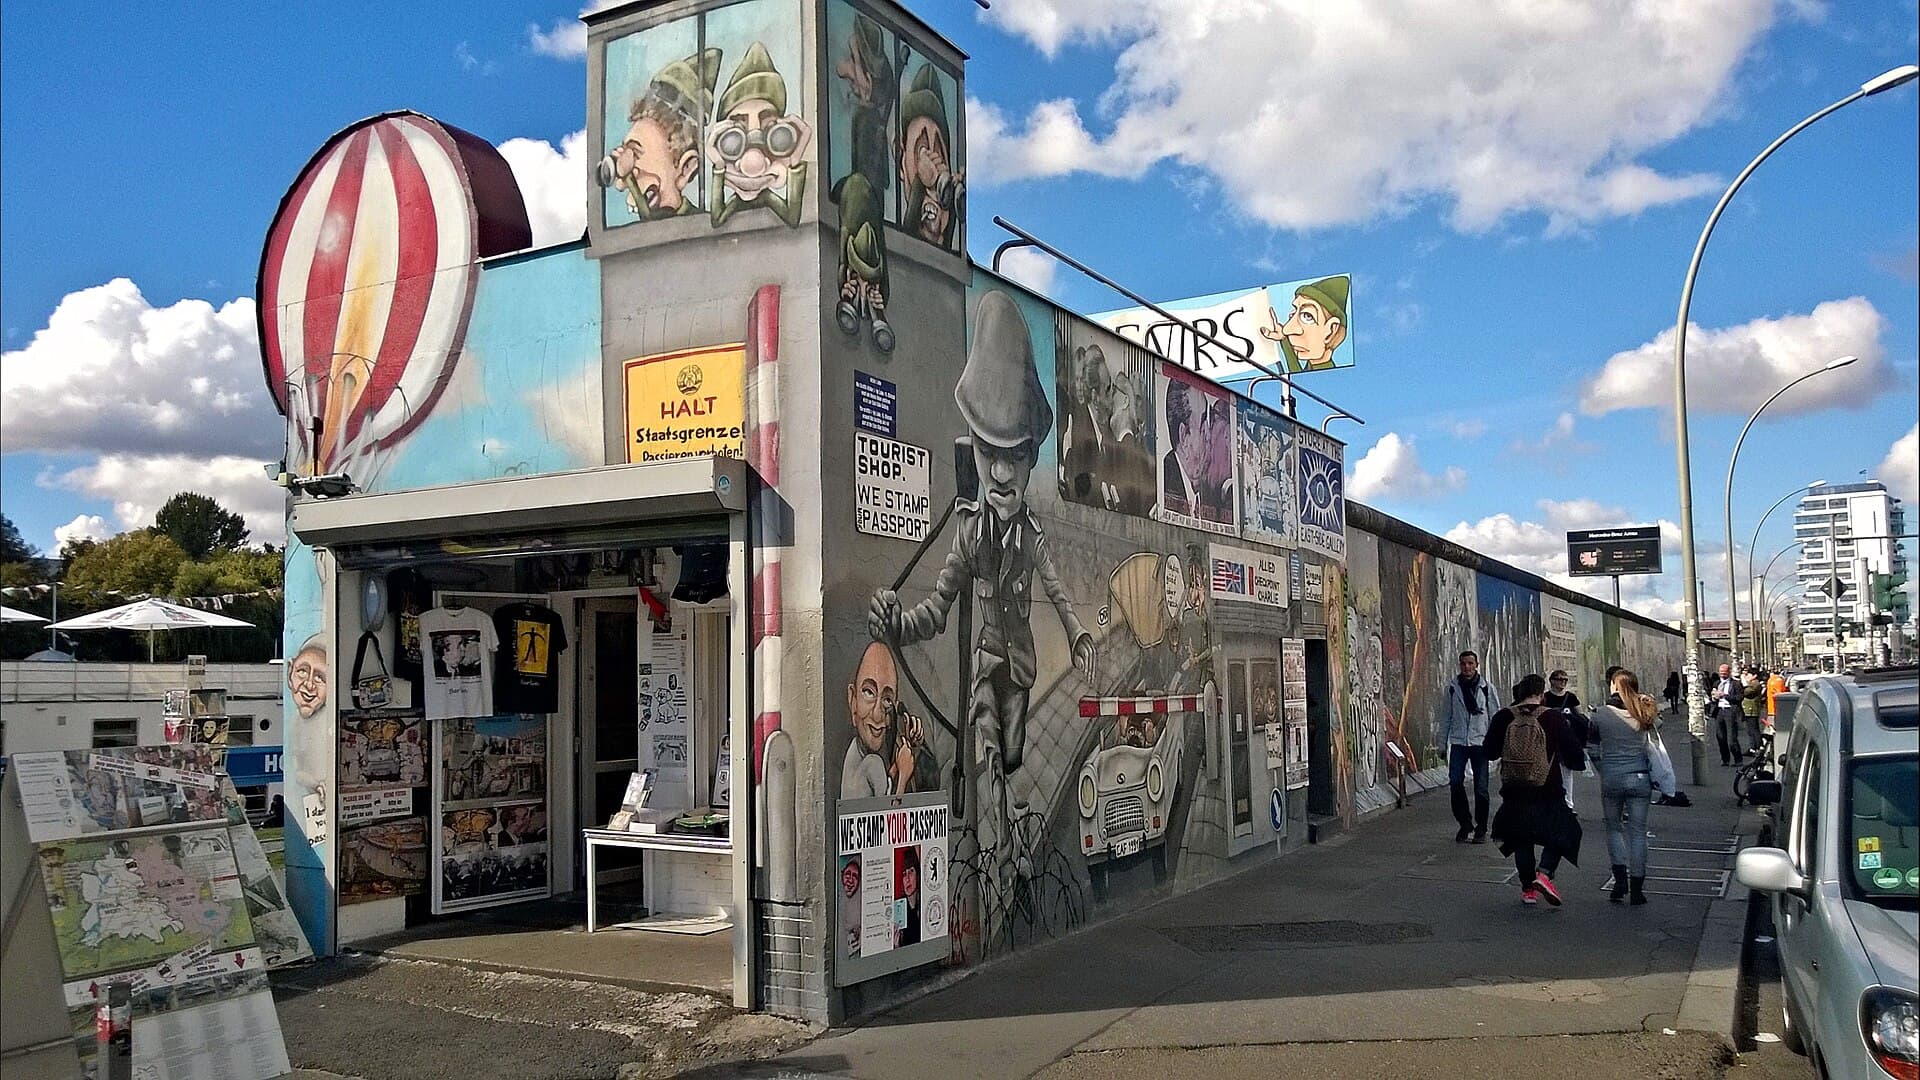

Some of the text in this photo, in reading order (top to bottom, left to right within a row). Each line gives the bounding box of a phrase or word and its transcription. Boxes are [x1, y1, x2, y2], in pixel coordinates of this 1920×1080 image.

[660, 396, 718, 419] HALT
[636, 421, 746, 443] Staatsgrenze!
[1299, 428, 1321, 451] STORE
[858, 436, 926, 468] TOURIST
[858, 454, 906, 481] SHOP.
[857, 483, 929, 515] WE STAMP
[862, 509, 929, 538] PASSPORT
[1258, 559, 1276, 574] ALLIED
[1254, 575, 1280, 591] CHECKPOINT
[1257, 590, 1279, 605] CHARLIE
[840, 808, 947, 851] WE STAMP YOUR PASSPORT
